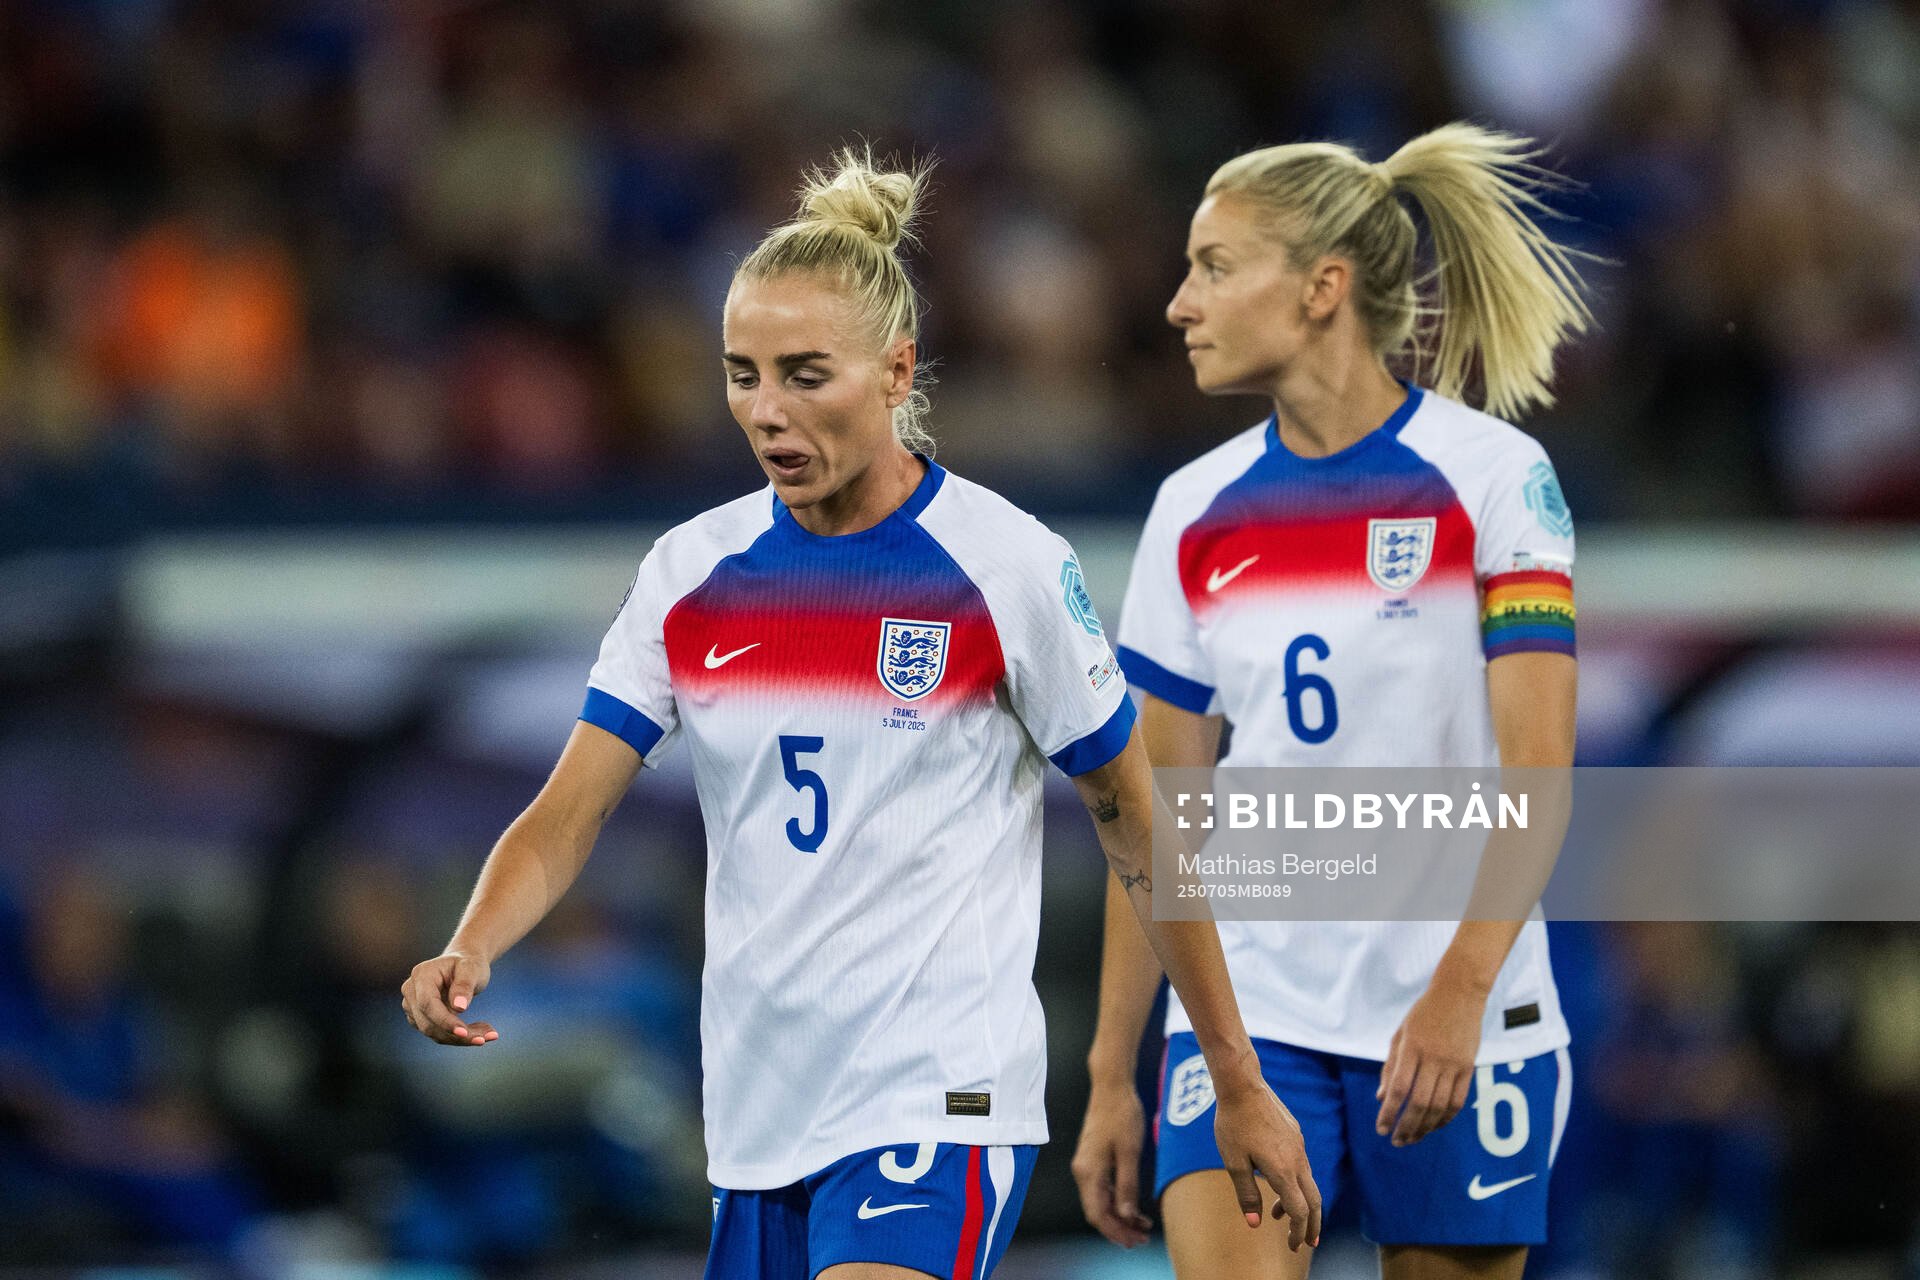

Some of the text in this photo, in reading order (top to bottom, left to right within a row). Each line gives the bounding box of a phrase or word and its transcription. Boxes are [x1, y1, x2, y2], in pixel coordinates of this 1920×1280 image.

[882, 718, 926, 731] 5 JULY 2025
[893, 707, 918, 719] FRANCE
[1282, 634, 1338, 744] 6
[778, 735, 828, 853] 5
[1471, 1059, 1530, 1157] 6
